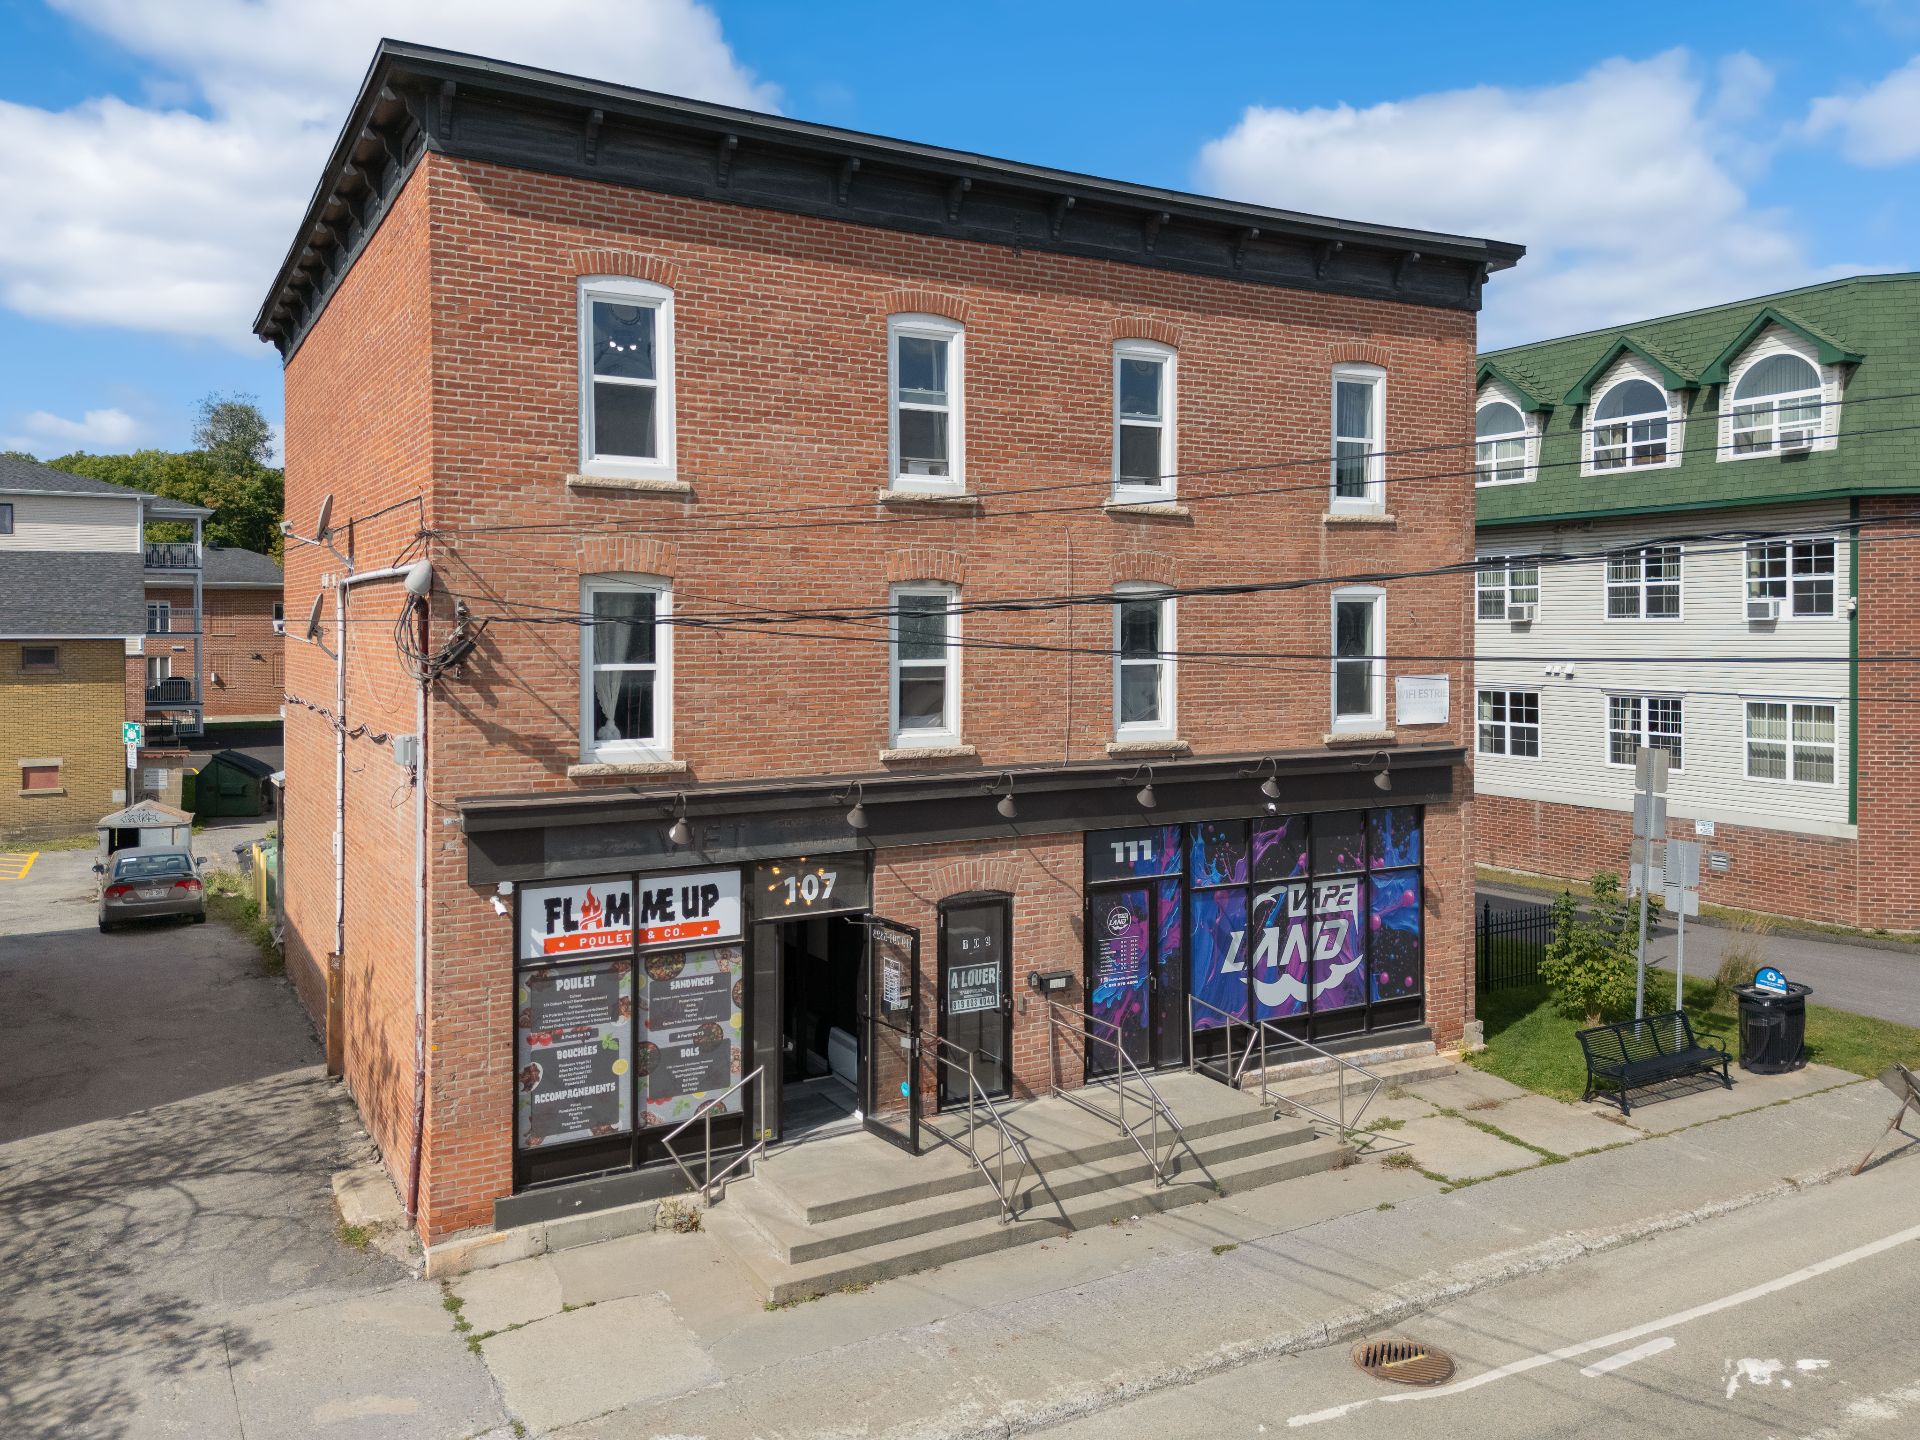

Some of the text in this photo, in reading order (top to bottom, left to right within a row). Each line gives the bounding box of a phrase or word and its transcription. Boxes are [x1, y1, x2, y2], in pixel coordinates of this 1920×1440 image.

[1111, 840, 1152, 863] 111
[784, 871, 837, 903] 107
[1292, 883, 1356, 912] VAPE
[681, 883, 720, 920] UP
[580, 928, 685, 947] POULET & CO.
[1221, 918, 1349, 974] LAND
[556, 975, 597, 991] POULET
[670, 975, 714, 991] SANDWICHS
[951, 967, 996, 989] A LOUER
[680, 1046, 700, 1058] BOLS
[534, 1082, 616, 1104] ACCOMPAGNEMENTS
